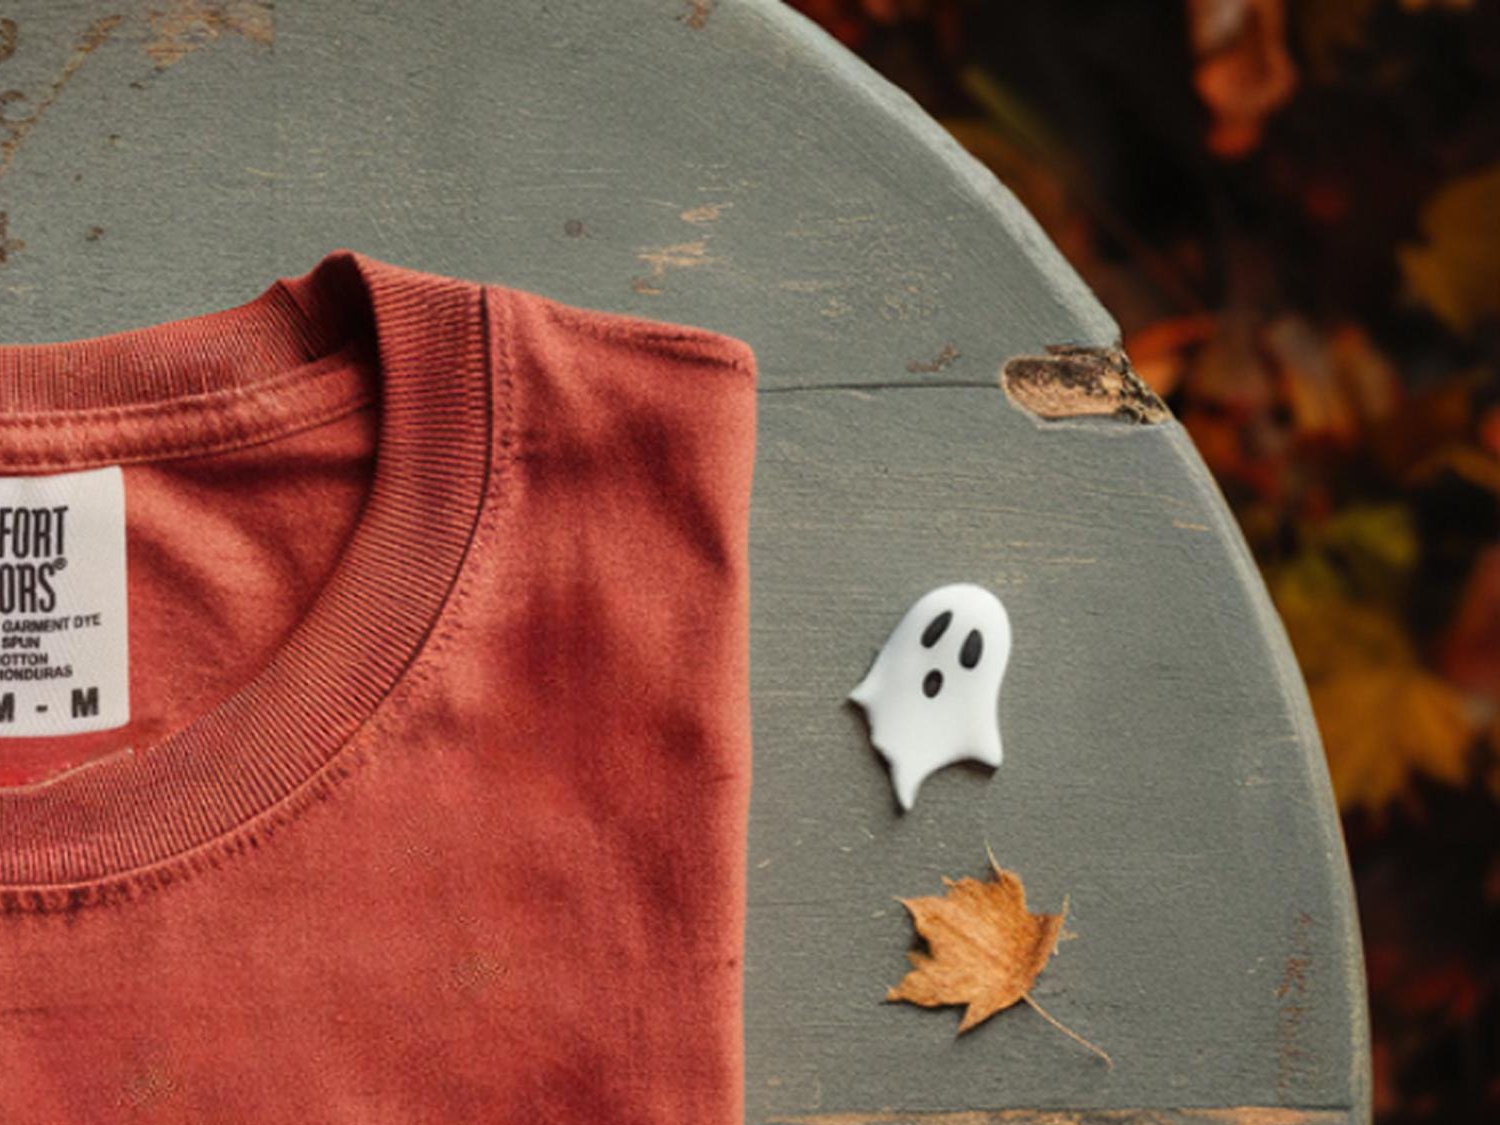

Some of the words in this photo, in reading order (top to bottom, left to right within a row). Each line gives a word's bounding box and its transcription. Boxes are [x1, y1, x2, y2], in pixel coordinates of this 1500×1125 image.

[2, 616, 70, 633] GARMENT
[73, 613, 102, 628] DYE
[2, 636, 40, 649] SPUN
[71, 687, 99, 718] M
